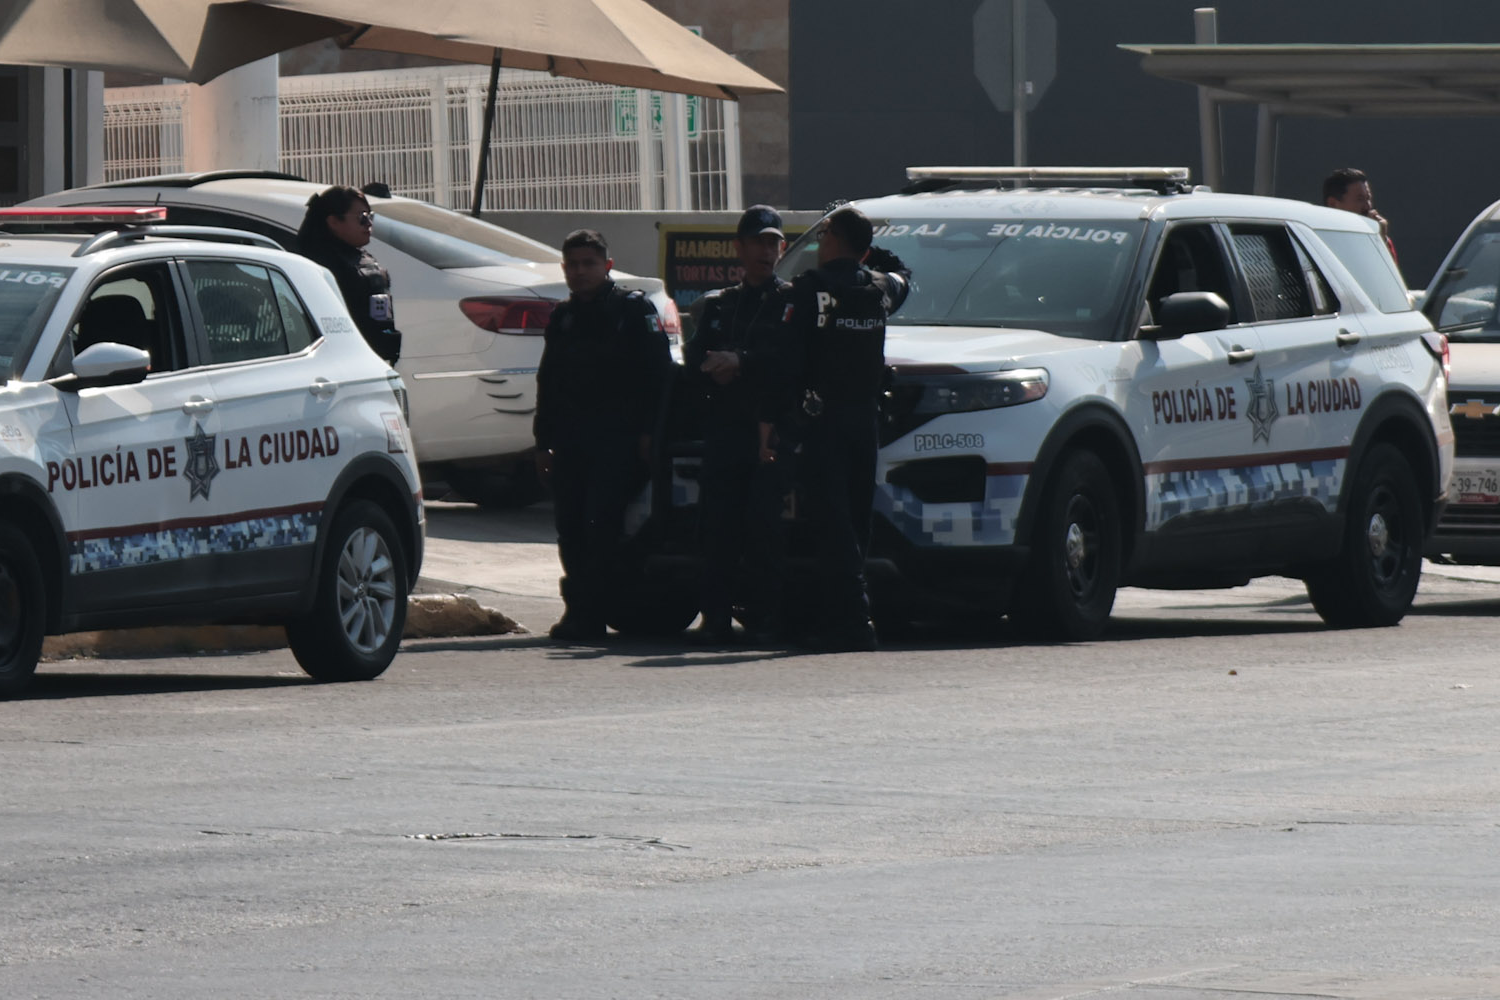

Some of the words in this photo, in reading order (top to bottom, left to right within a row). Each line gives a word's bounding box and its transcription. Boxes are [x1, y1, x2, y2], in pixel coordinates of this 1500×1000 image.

[675, 265, 725, 281] TORTAS
[836, 318, 884, 329] POLICIA
[1152, 380, 1213, 424] POLICÍA
[1215, 387, 1236, 420] DE
[1286, 382, 1304, 415] LA
[1308, 377, 1361, 413] CIUDAD
[914, 433, 985, 451] PDLC-508
[46, 445, 140, 492] POLICÍA
[147, 446, 177, 479] DE
[225, 436, 252, 469] LA
[259, 426, 339, 465] CIUDAD
[1451, 477, 1498, 493] -39-746
